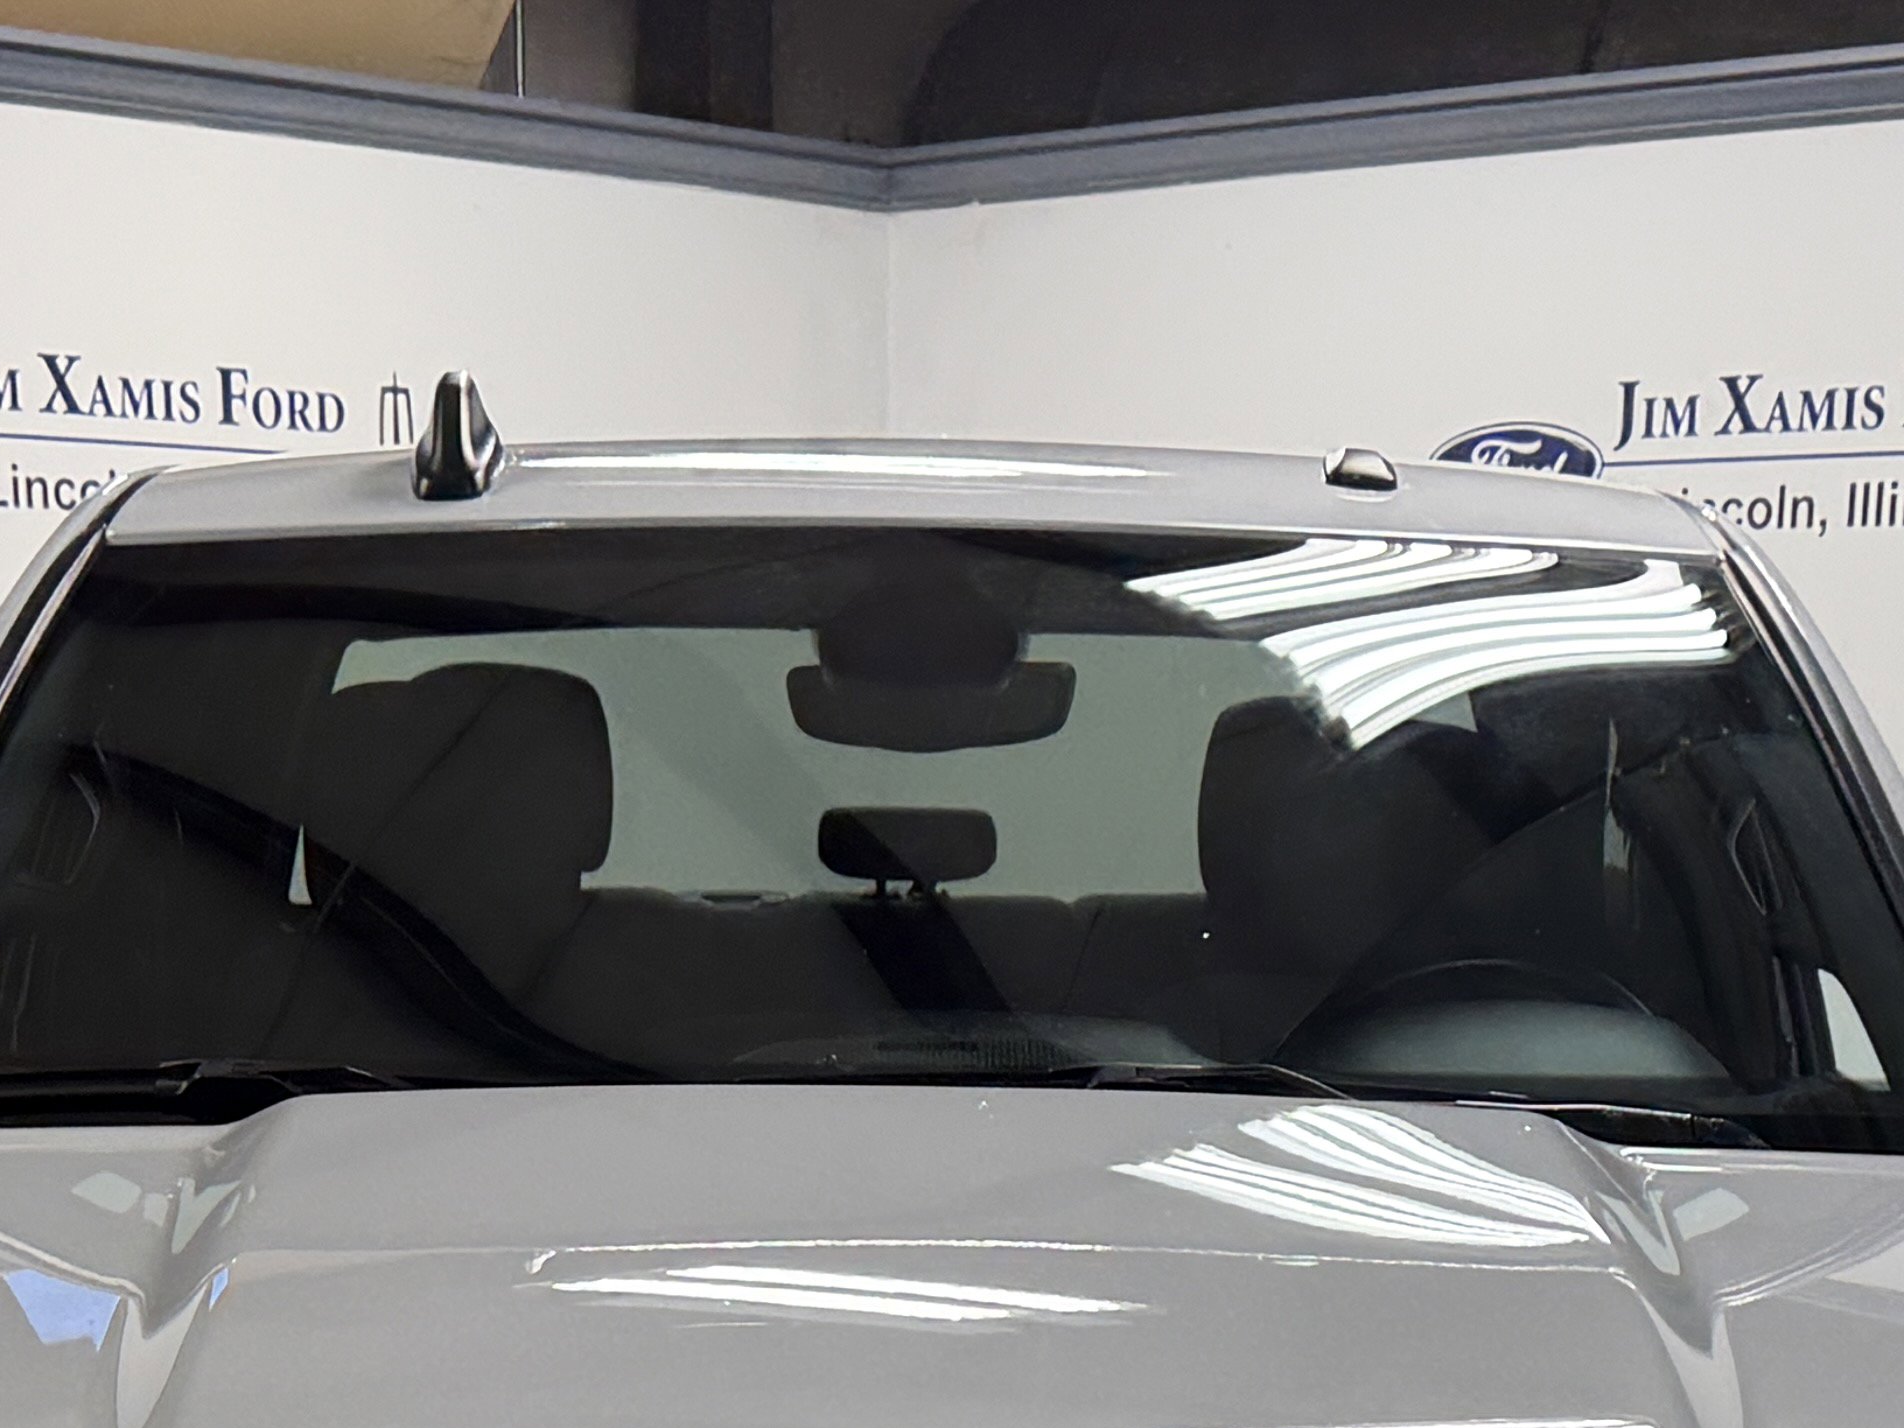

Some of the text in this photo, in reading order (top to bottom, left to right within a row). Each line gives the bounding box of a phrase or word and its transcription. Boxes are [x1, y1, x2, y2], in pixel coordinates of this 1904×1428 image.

[38, 353, 200, 423] XAMIS
[217, 367, 344, 432] FORD
[1614, 381, 1698, 451] JIM
[1715, 375, 1884, 435] XAMIS
